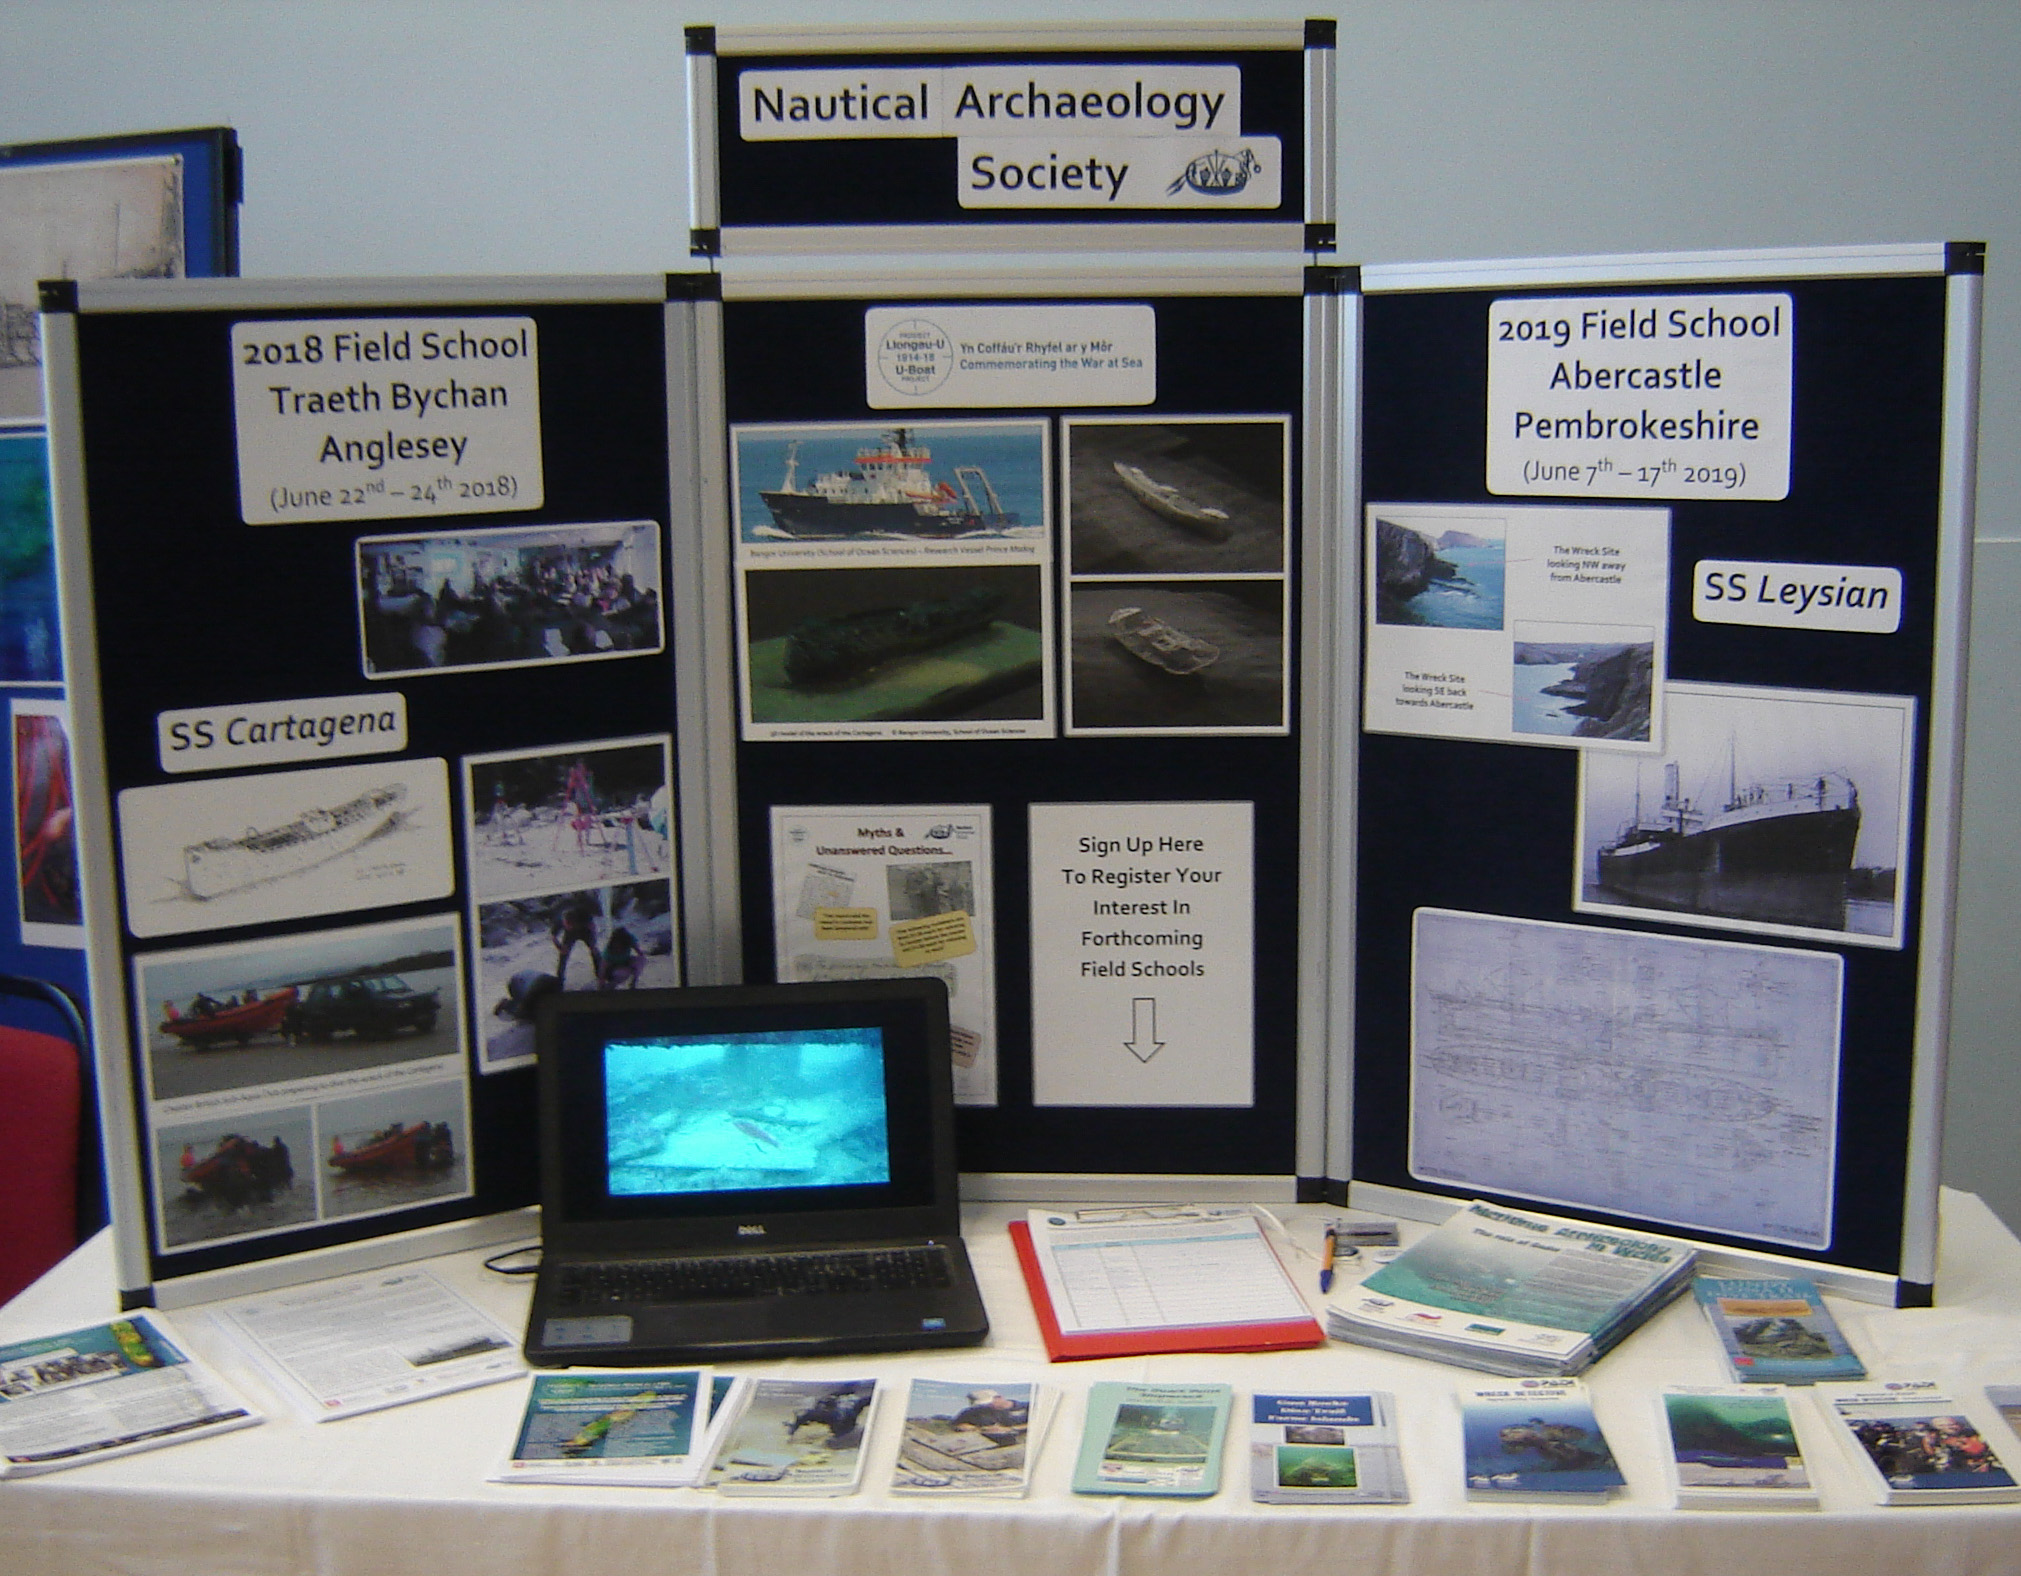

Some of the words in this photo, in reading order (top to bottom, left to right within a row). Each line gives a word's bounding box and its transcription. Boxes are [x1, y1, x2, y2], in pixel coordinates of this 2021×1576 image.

[755, 83, 927, 121] Nautical
[956, 82, 1224, 129] Archaeology
[972, 153, 1128, 201] Society
[1500, 320, 1570, 347] 2019
[1583, 309, 1656, 339] Field
[1669, 306, 1779, 338] School
[244, 335, 323, 364] 2018
[335, 331, 410, 362] Field
[422, 329, 527, 359] School
[886, 339, 945, 351] Llongau-U
[961, 343, 974, 354] Yn
[1026, 342, 1062, 355] Rhyfel
[1066, 344, 1077, 352] ar
[1081, 345, 1087, 354] y
[897, 353, 935, 362] 1914-18
[960, 354, 1057, 371] Commemorating
[1060, 358, 1078, 368] the
[1081, 358, 1104, 368] War
[1108, 358, 1118, 368] at
[1122, 357, 1142, 368] Sea
[896, 365, 936, 375] U-Boat
[1550, 359, 1721, 389] Abercastle
[269, 382, 380, 414] Traeth
[392, 379, 507, 418] Bychan
[1516, 410, 1758, 439] Pembrokeshire
[320, 431, 467, 470] Anglesey
[1524, 461, 1579, 484] (June
[1685, 463, 1745, 489] 2019)
[271, 488, 331, 513] (June
[460, 476, 517, 498] 2018)
[1554, 546, 1572, 556] The
[1573, 546, 1601, 557] Wreck
[1602, 547, 1621, 557] Site
[1546, 559, 1580, 572] looking
[1582, 560, 1601, 571] NW
[1602, 563, 1627, 573] away
[1550, 573, 1572, 583] from
[1573, 573, 1623, 584] Abercastle
[1706, 573, 1746, 601] SS
[1758, 576, 1887, 614] Leysian
[1405, 671, 1421, 682] The
[1422, 673, 1447, 683] Wreck
[1448, 674, 1466, 684] Site
[1402, 684, 1433, 697] looking
[1434, 687, 1446, 697] SE
[1447, 687, 1468, 698] back
[1395, 698, 1429, 709] towards
[1430, 699, 1475, 711] Abercastle
[171, 721, 214, 751] SS
[227, 709, 396, 747] Cartagena
[858, 828, 892, 839] Myths
[896, 828, 904, 837] &
[817, 846, 885, 855] Unanswered
[1079, 837, 1120, 857] Sign
[1127, 837, 1152, 856] Up
[1160, 837, 1203, 851] Here
[1062, 869, 1085, 884] To
[1092, 868, 1171, 888] Register
[1176, 868, 1222, 882] Your
[1094, 901, 1167, 915] Interest
[1174, 900, 1190, 914] In
[1082, 930, 1202, 950] Forthcoming
[1082, 961, 1125, 977] Field
[1132, 961, 1204, 976] Schools
[738, 1225, 765, 1235] DELL
